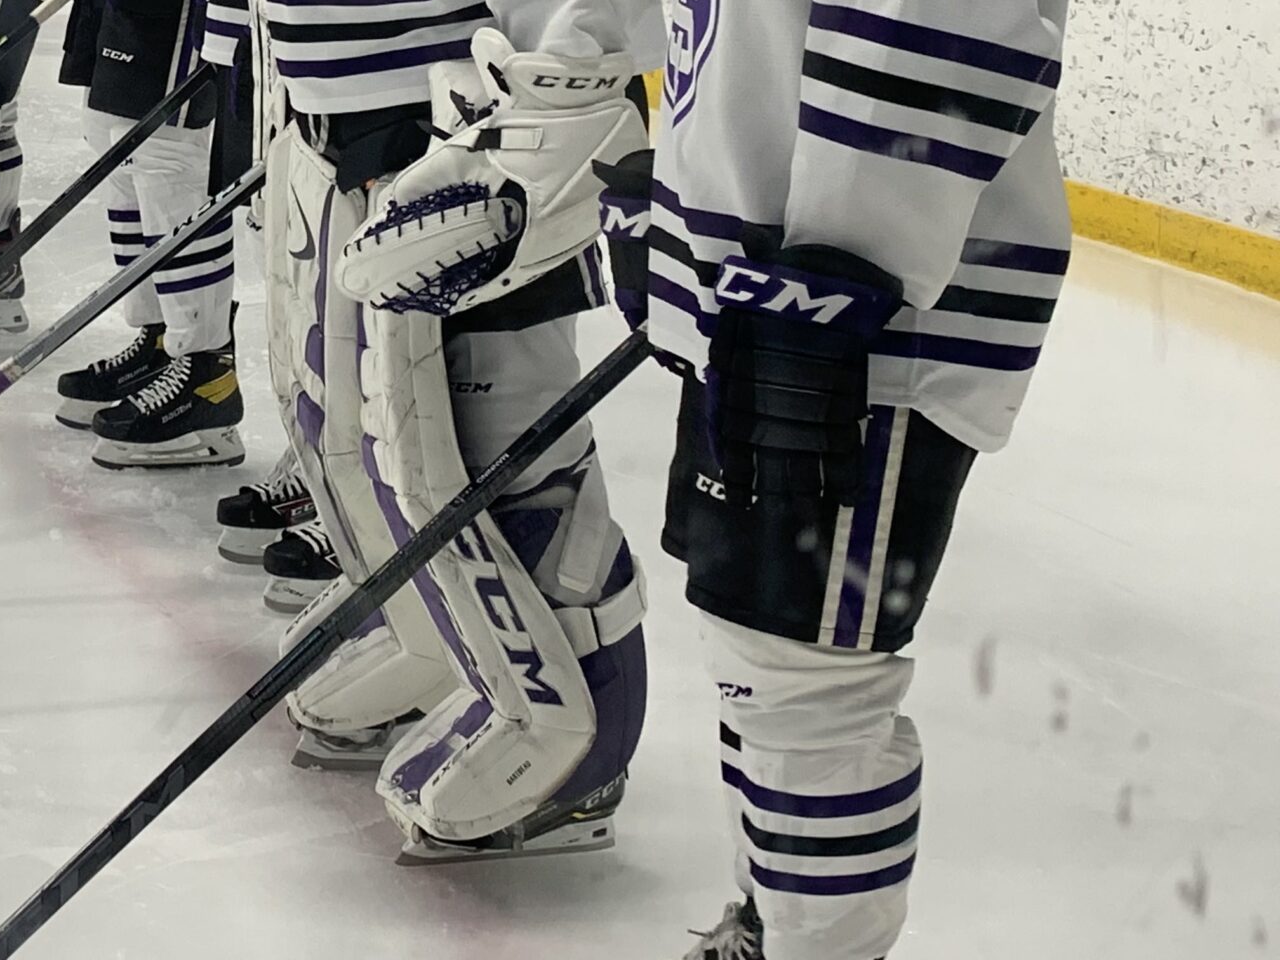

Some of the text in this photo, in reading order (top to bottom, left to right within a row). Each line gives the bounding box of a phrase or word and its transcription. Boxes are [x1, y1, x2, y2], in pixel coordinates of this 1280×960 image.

[101, 47, 135, 63] CCM
[532, 74, 620, 90] CCM
[696, 472, 727, 501] CC
